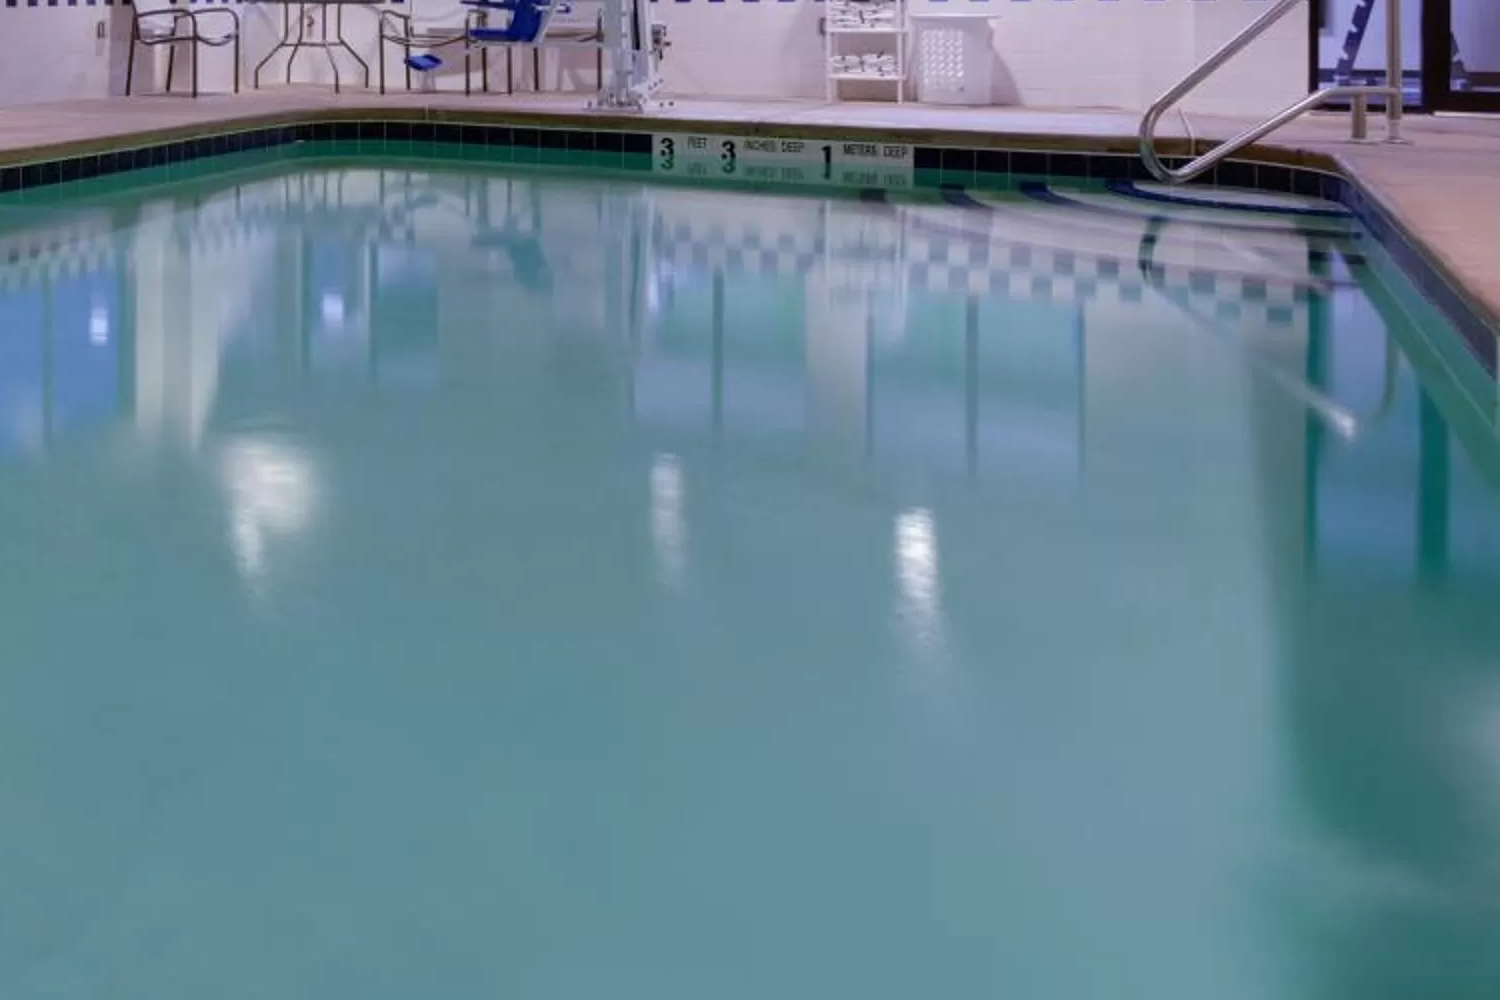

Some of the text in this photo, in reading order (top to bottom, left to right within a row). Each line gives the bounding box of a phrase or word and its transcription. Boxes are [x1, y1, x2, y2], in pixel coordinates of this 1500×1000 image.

[660, 137, 675, 157] 3
[721, 140, 736, 160] 3
[781, 141, 805, 153] DEEP
[821, 145, 832, 164] 1
[883, 145, 908, 159] DEEP
